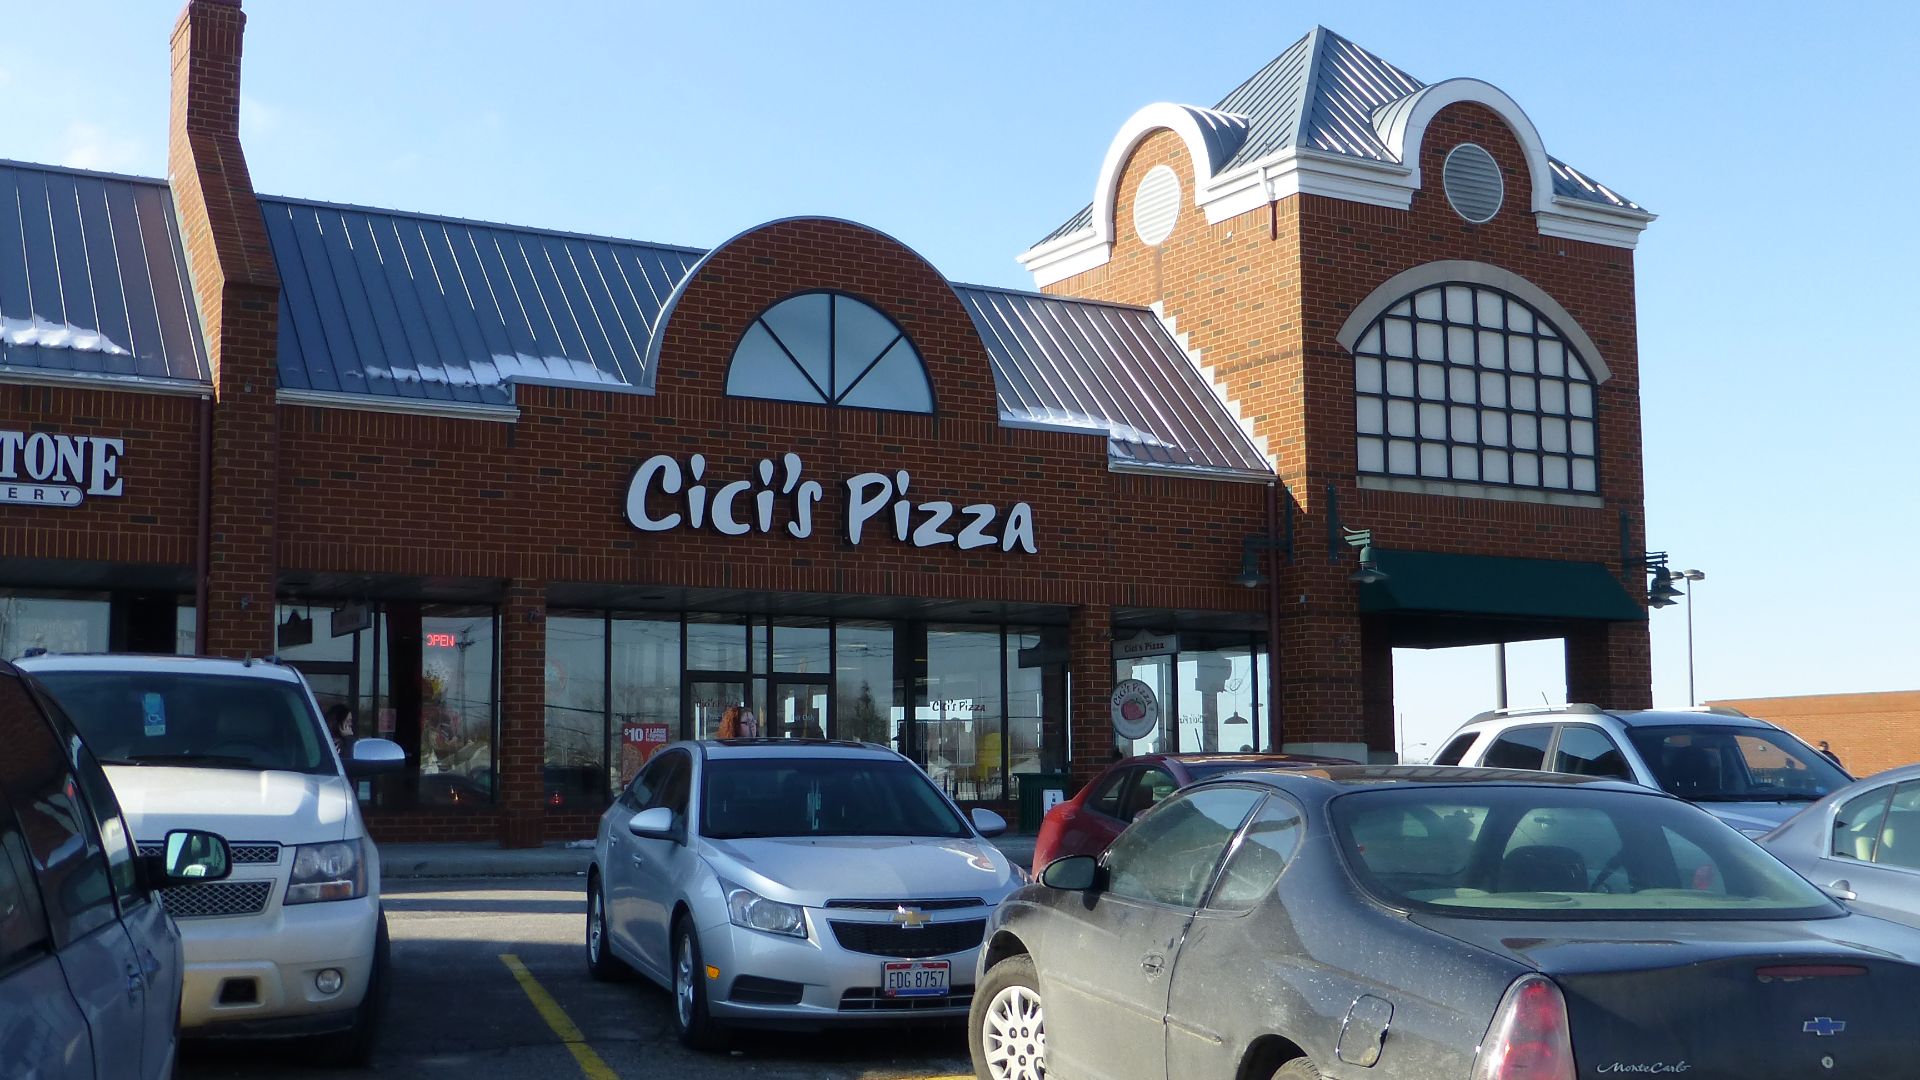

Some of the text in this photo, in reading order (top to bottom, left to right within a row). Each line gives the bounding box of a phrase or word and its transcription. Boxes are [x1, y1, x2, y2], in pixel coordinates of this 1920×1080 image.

[8, 487, 70, 501] ERY
[626, 453, 1037, 554] Cici's Pizza
[426, 632, 456, 647] OPEN
[932, 699, 985, 711] Cici's Pizza
[624, 727, 644, 741] $10
[889, 971, 945, 989] EDG 8757
